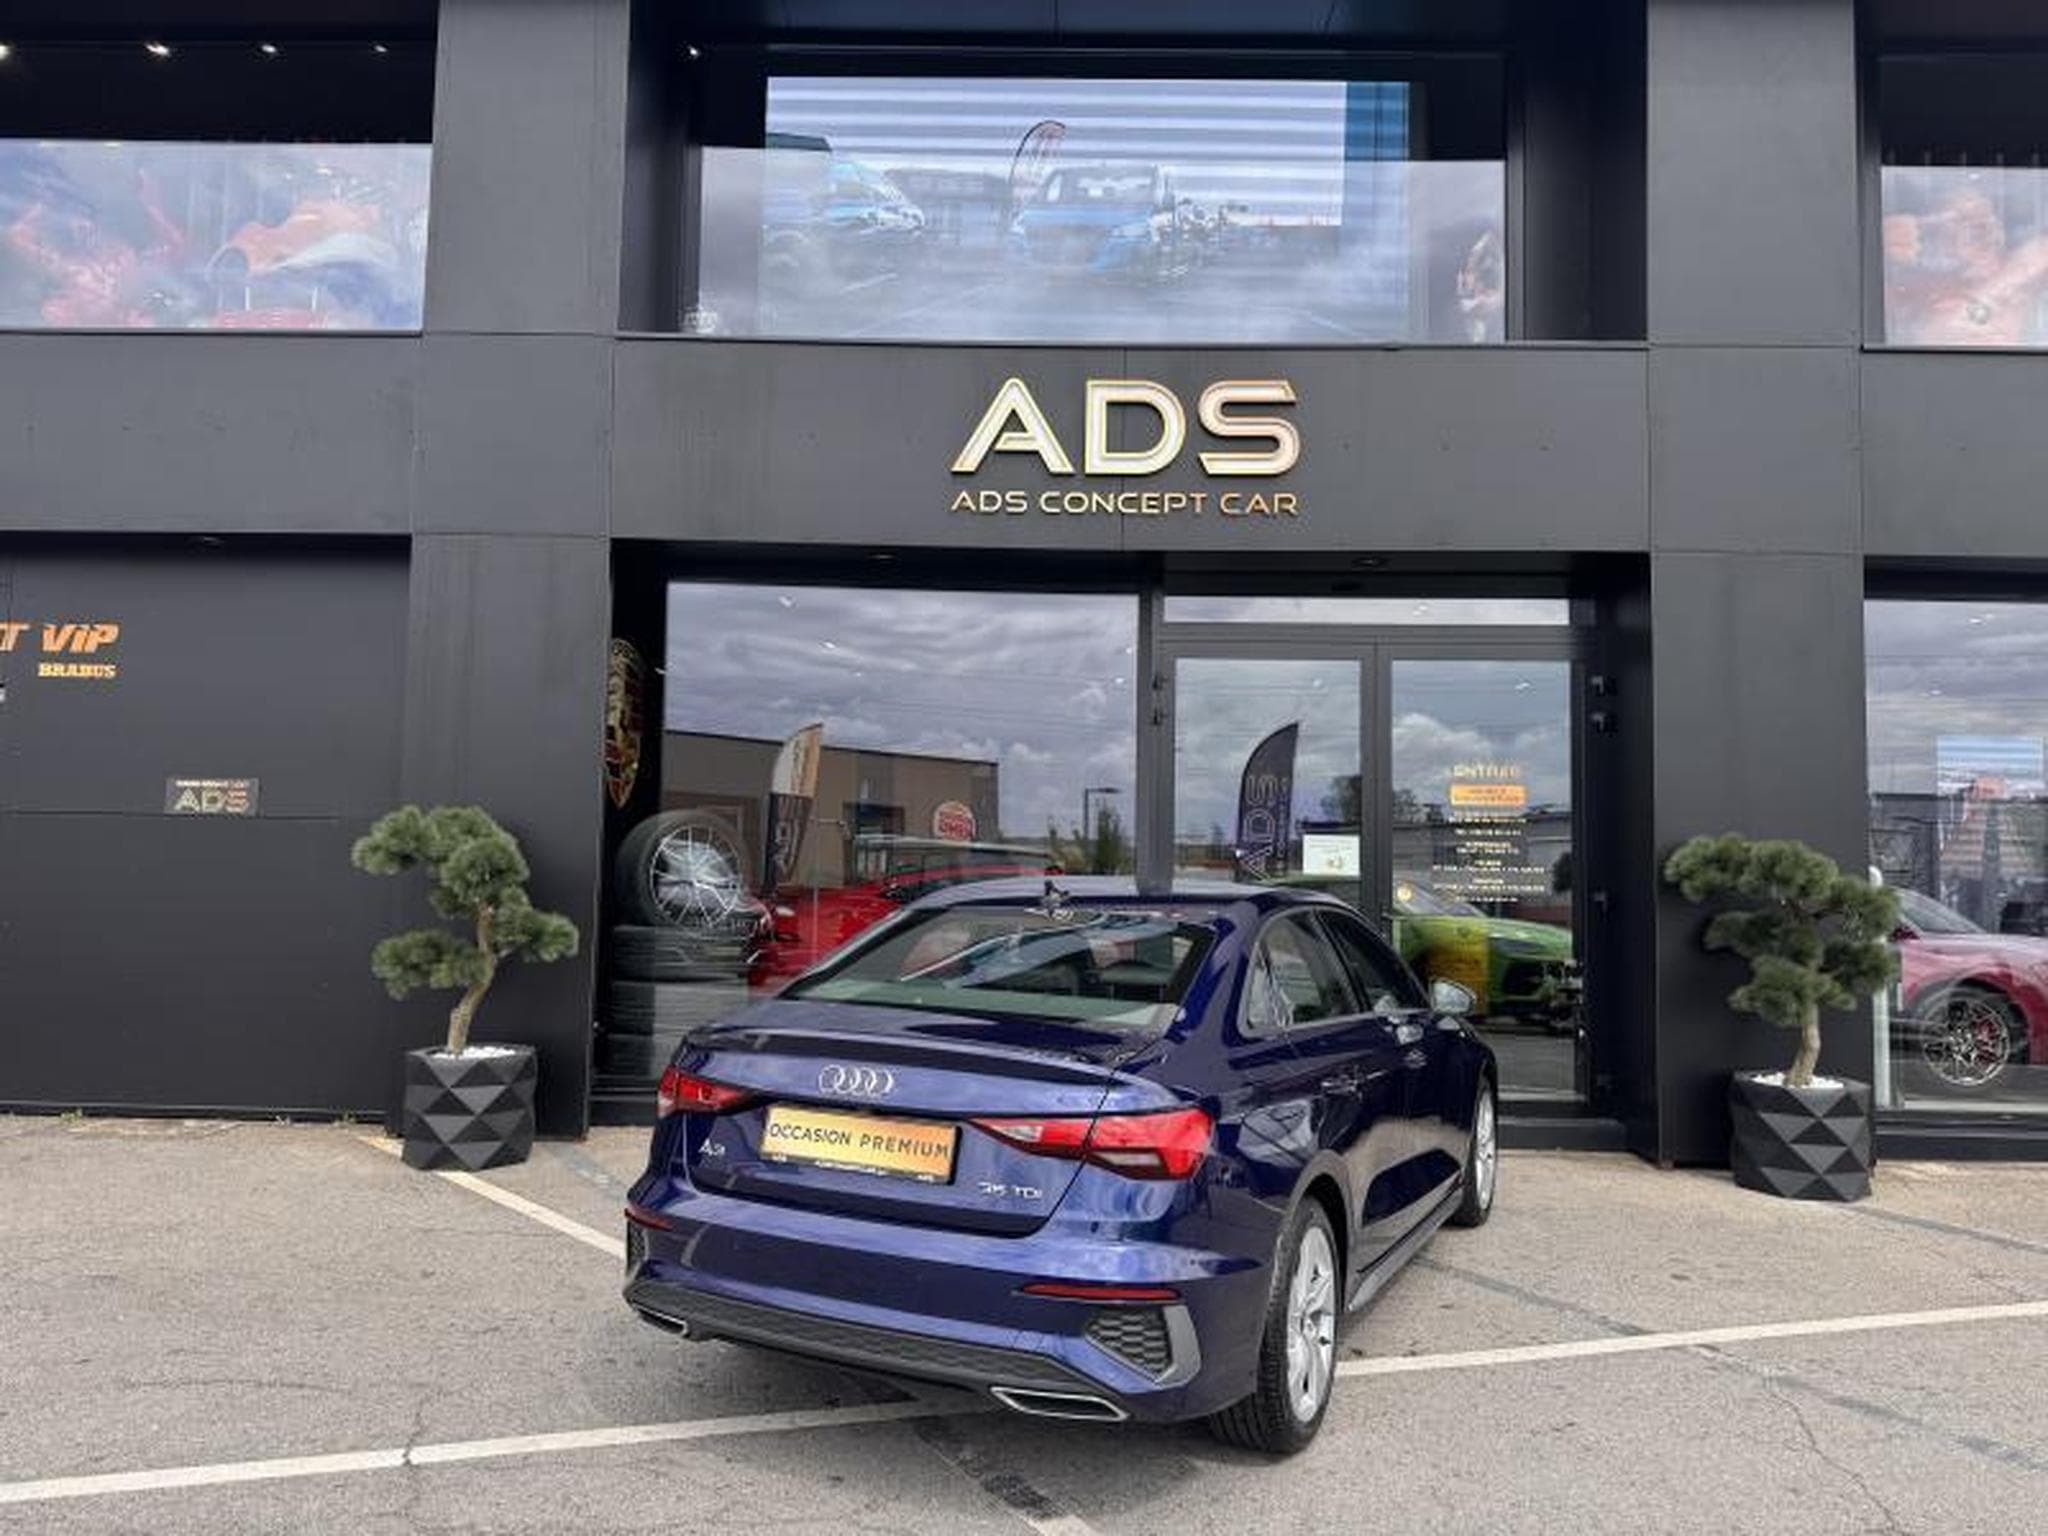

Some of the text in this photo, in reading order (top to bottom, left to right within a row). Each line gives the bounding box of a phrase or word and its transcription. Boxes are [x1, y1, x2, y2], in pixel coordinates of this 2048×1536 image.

[950, 377, 1300, 475] ADS
[951, 490, 1300, 516] ADS CONCEPT CAR
[174, 788, 249, 813] ADS
[770, 1123, 950, 1159] OCCASION PREMIUM
